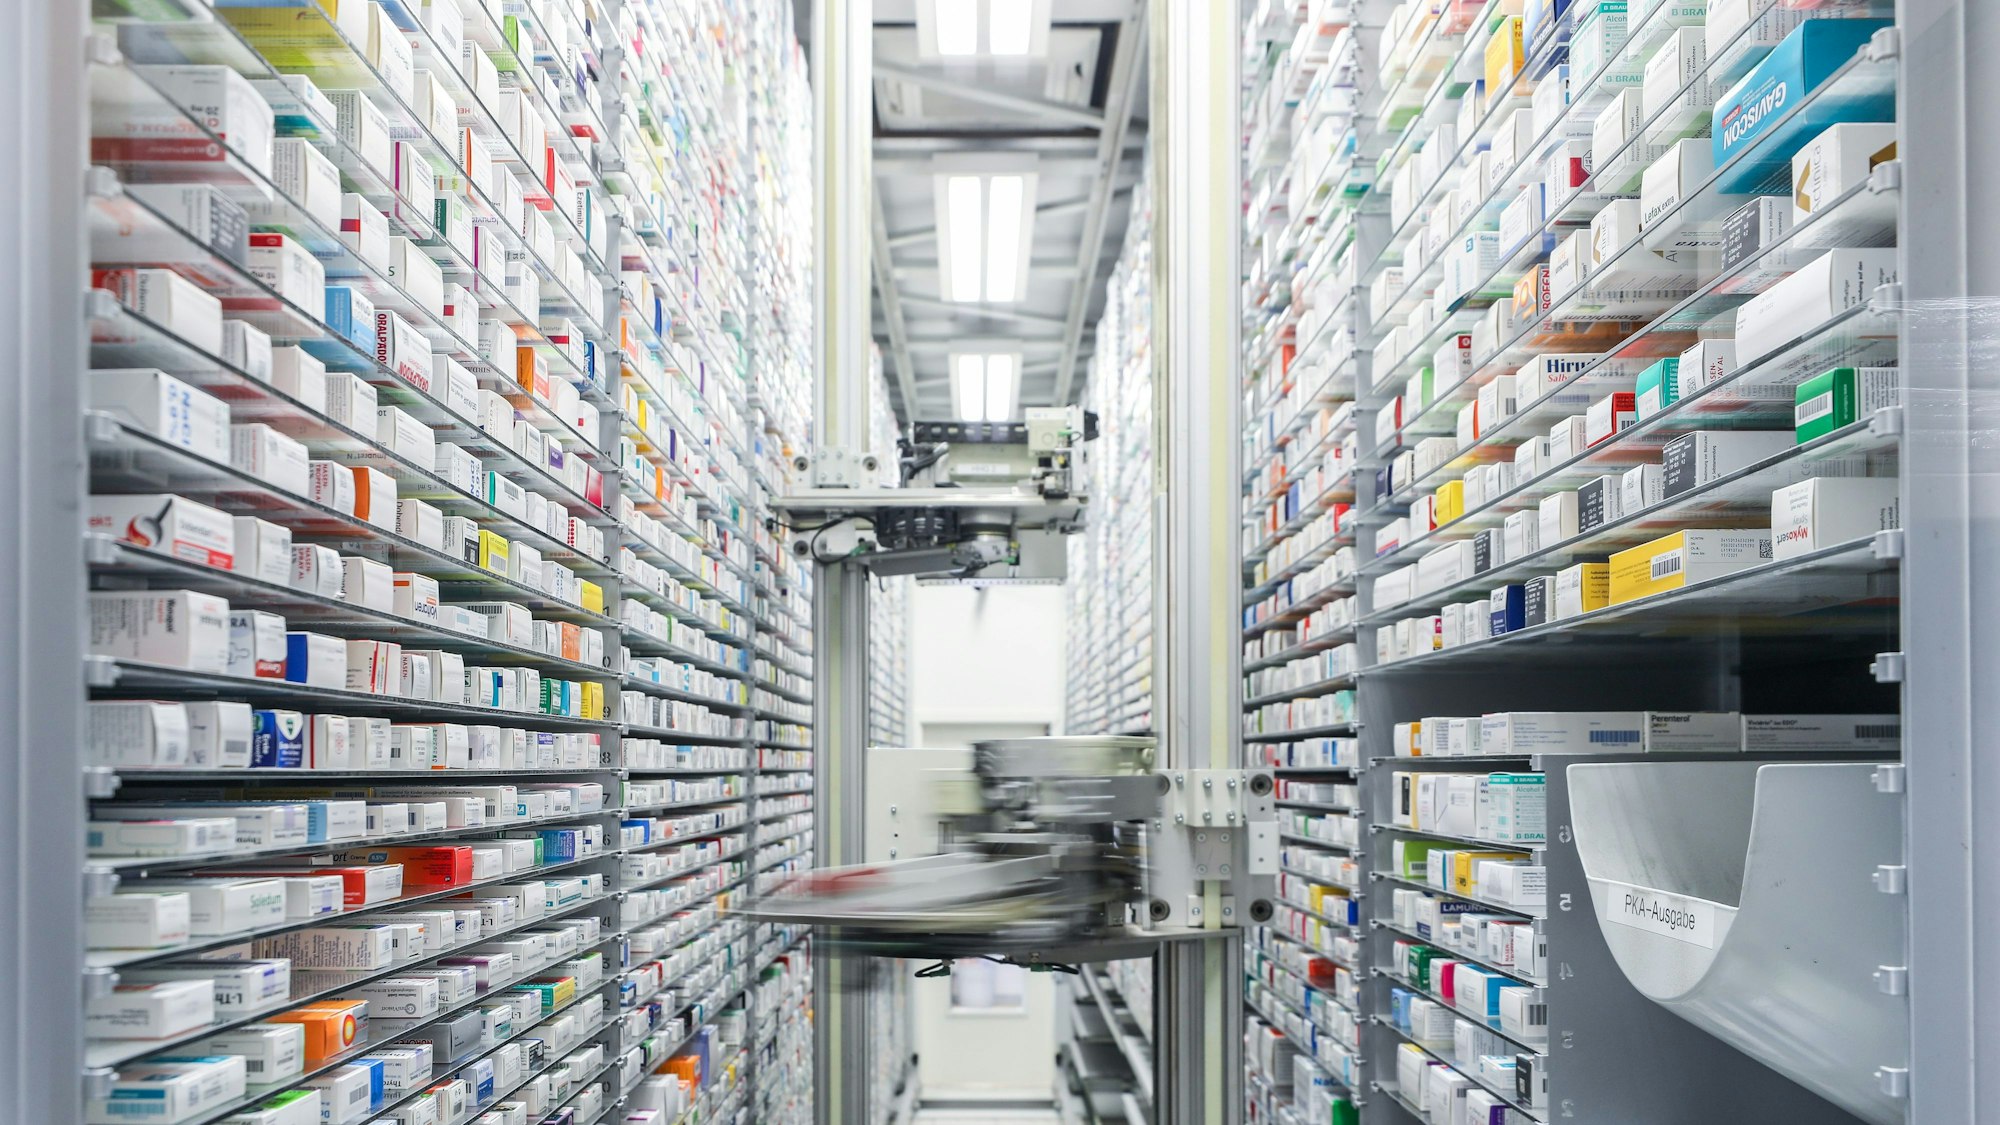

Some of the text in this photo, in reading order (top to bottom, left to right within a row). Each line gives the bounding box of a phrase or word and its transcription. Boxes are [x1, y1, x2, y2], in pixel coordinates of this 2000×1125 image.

[1606, 15, 1627, 23] Alcoh
[1615, 75, 1643, 83] BRAU
[1723, 81, 1787, 151] GAVISCON
[576, 192, 584, 228] Ezetimib/
[1644, 195, 1675, 225] Lefax extra
[1717, 356, 1724, 366] AL
[1548, 375, 1568, 383] Salb
[1792, 514, 1808, 528] Spray
[1776, 523, 1808, 546] Mykosert
[298, 571, 305, 581] AL
[414, 601, 438, 620] Voltaren
[1651, 714, 1691, 722] Perenterol
[603, 875, 611, 888] 5
[250, 892, 283, 909] Soledum
[1624, 894, 1696, 930] PKA-Ausgabe
